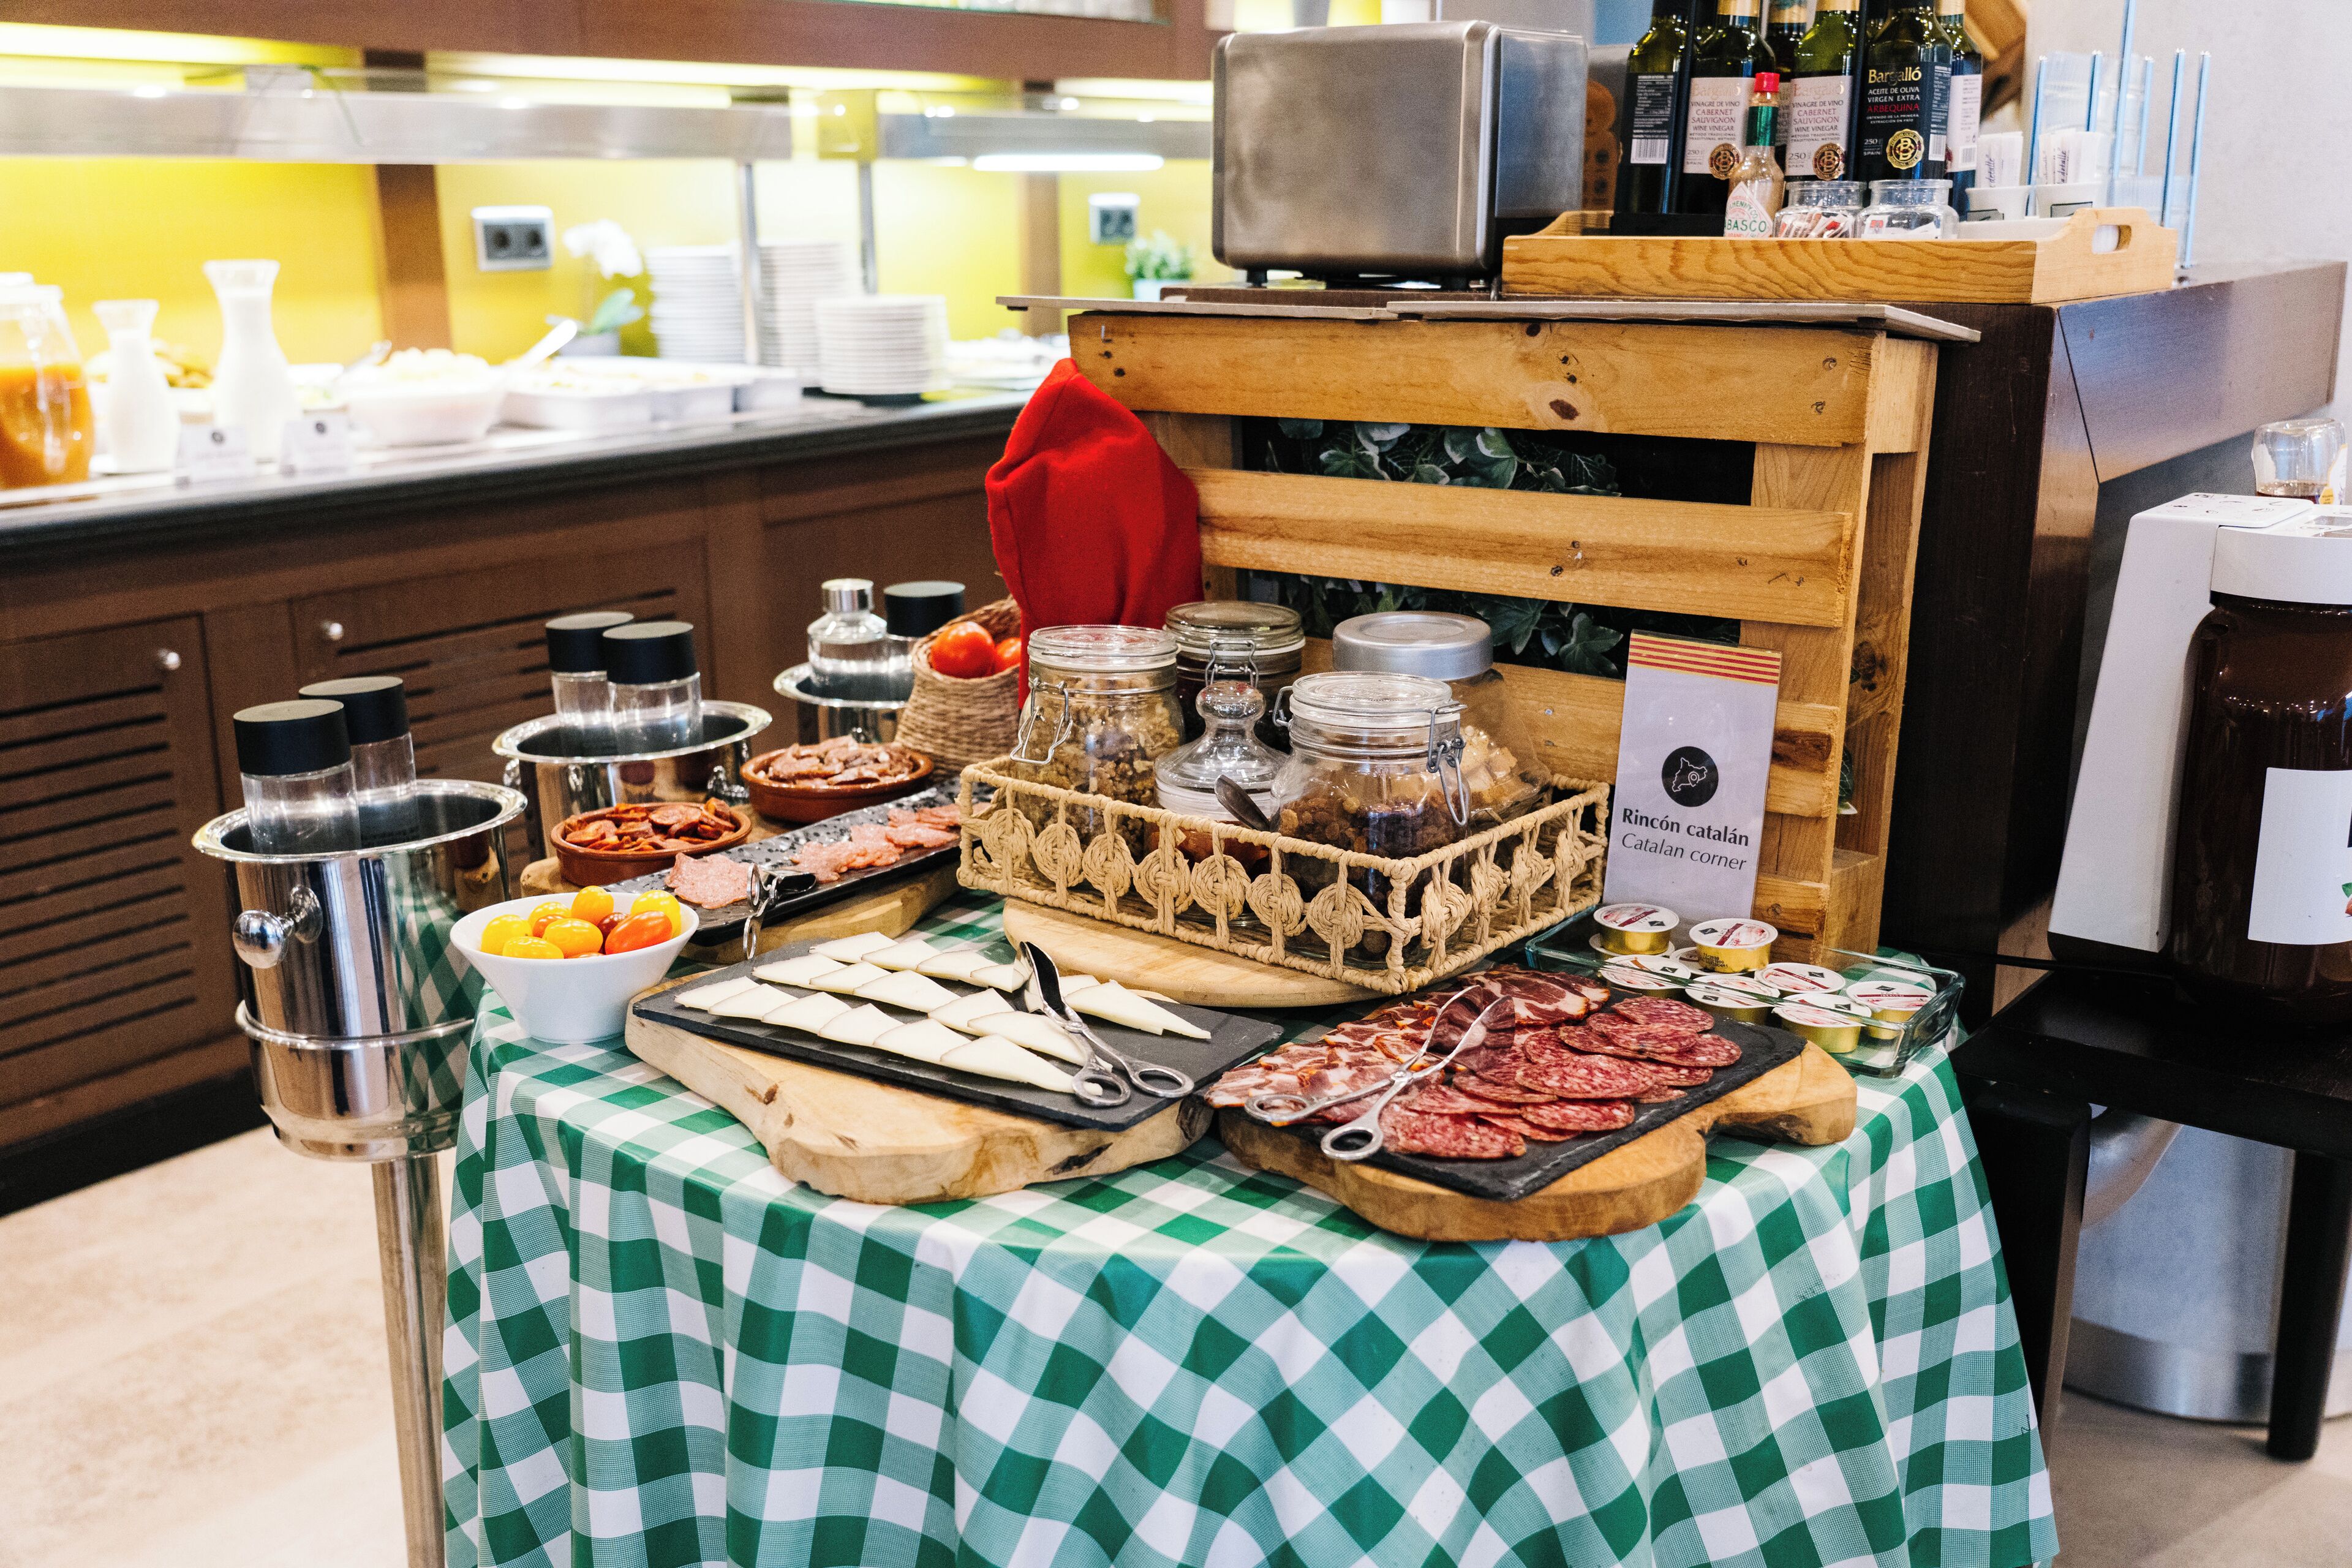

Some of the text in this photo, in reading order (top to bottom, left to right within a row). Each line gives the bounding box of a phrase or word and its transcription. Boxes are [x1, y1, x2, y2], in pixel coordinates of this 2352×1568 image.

[1868, 66, 1922, 86] Bargalló
[1867, 103, 1920, 113] ARBEQUINA
[1793, 116, 1839, 125] SAUVIGNON
[1724, 219, 1766, 232] ABASCO
[1622, 807, 1750, 847] Rincón catalán
[1621, 832, 1747, 871] Catalan corner
